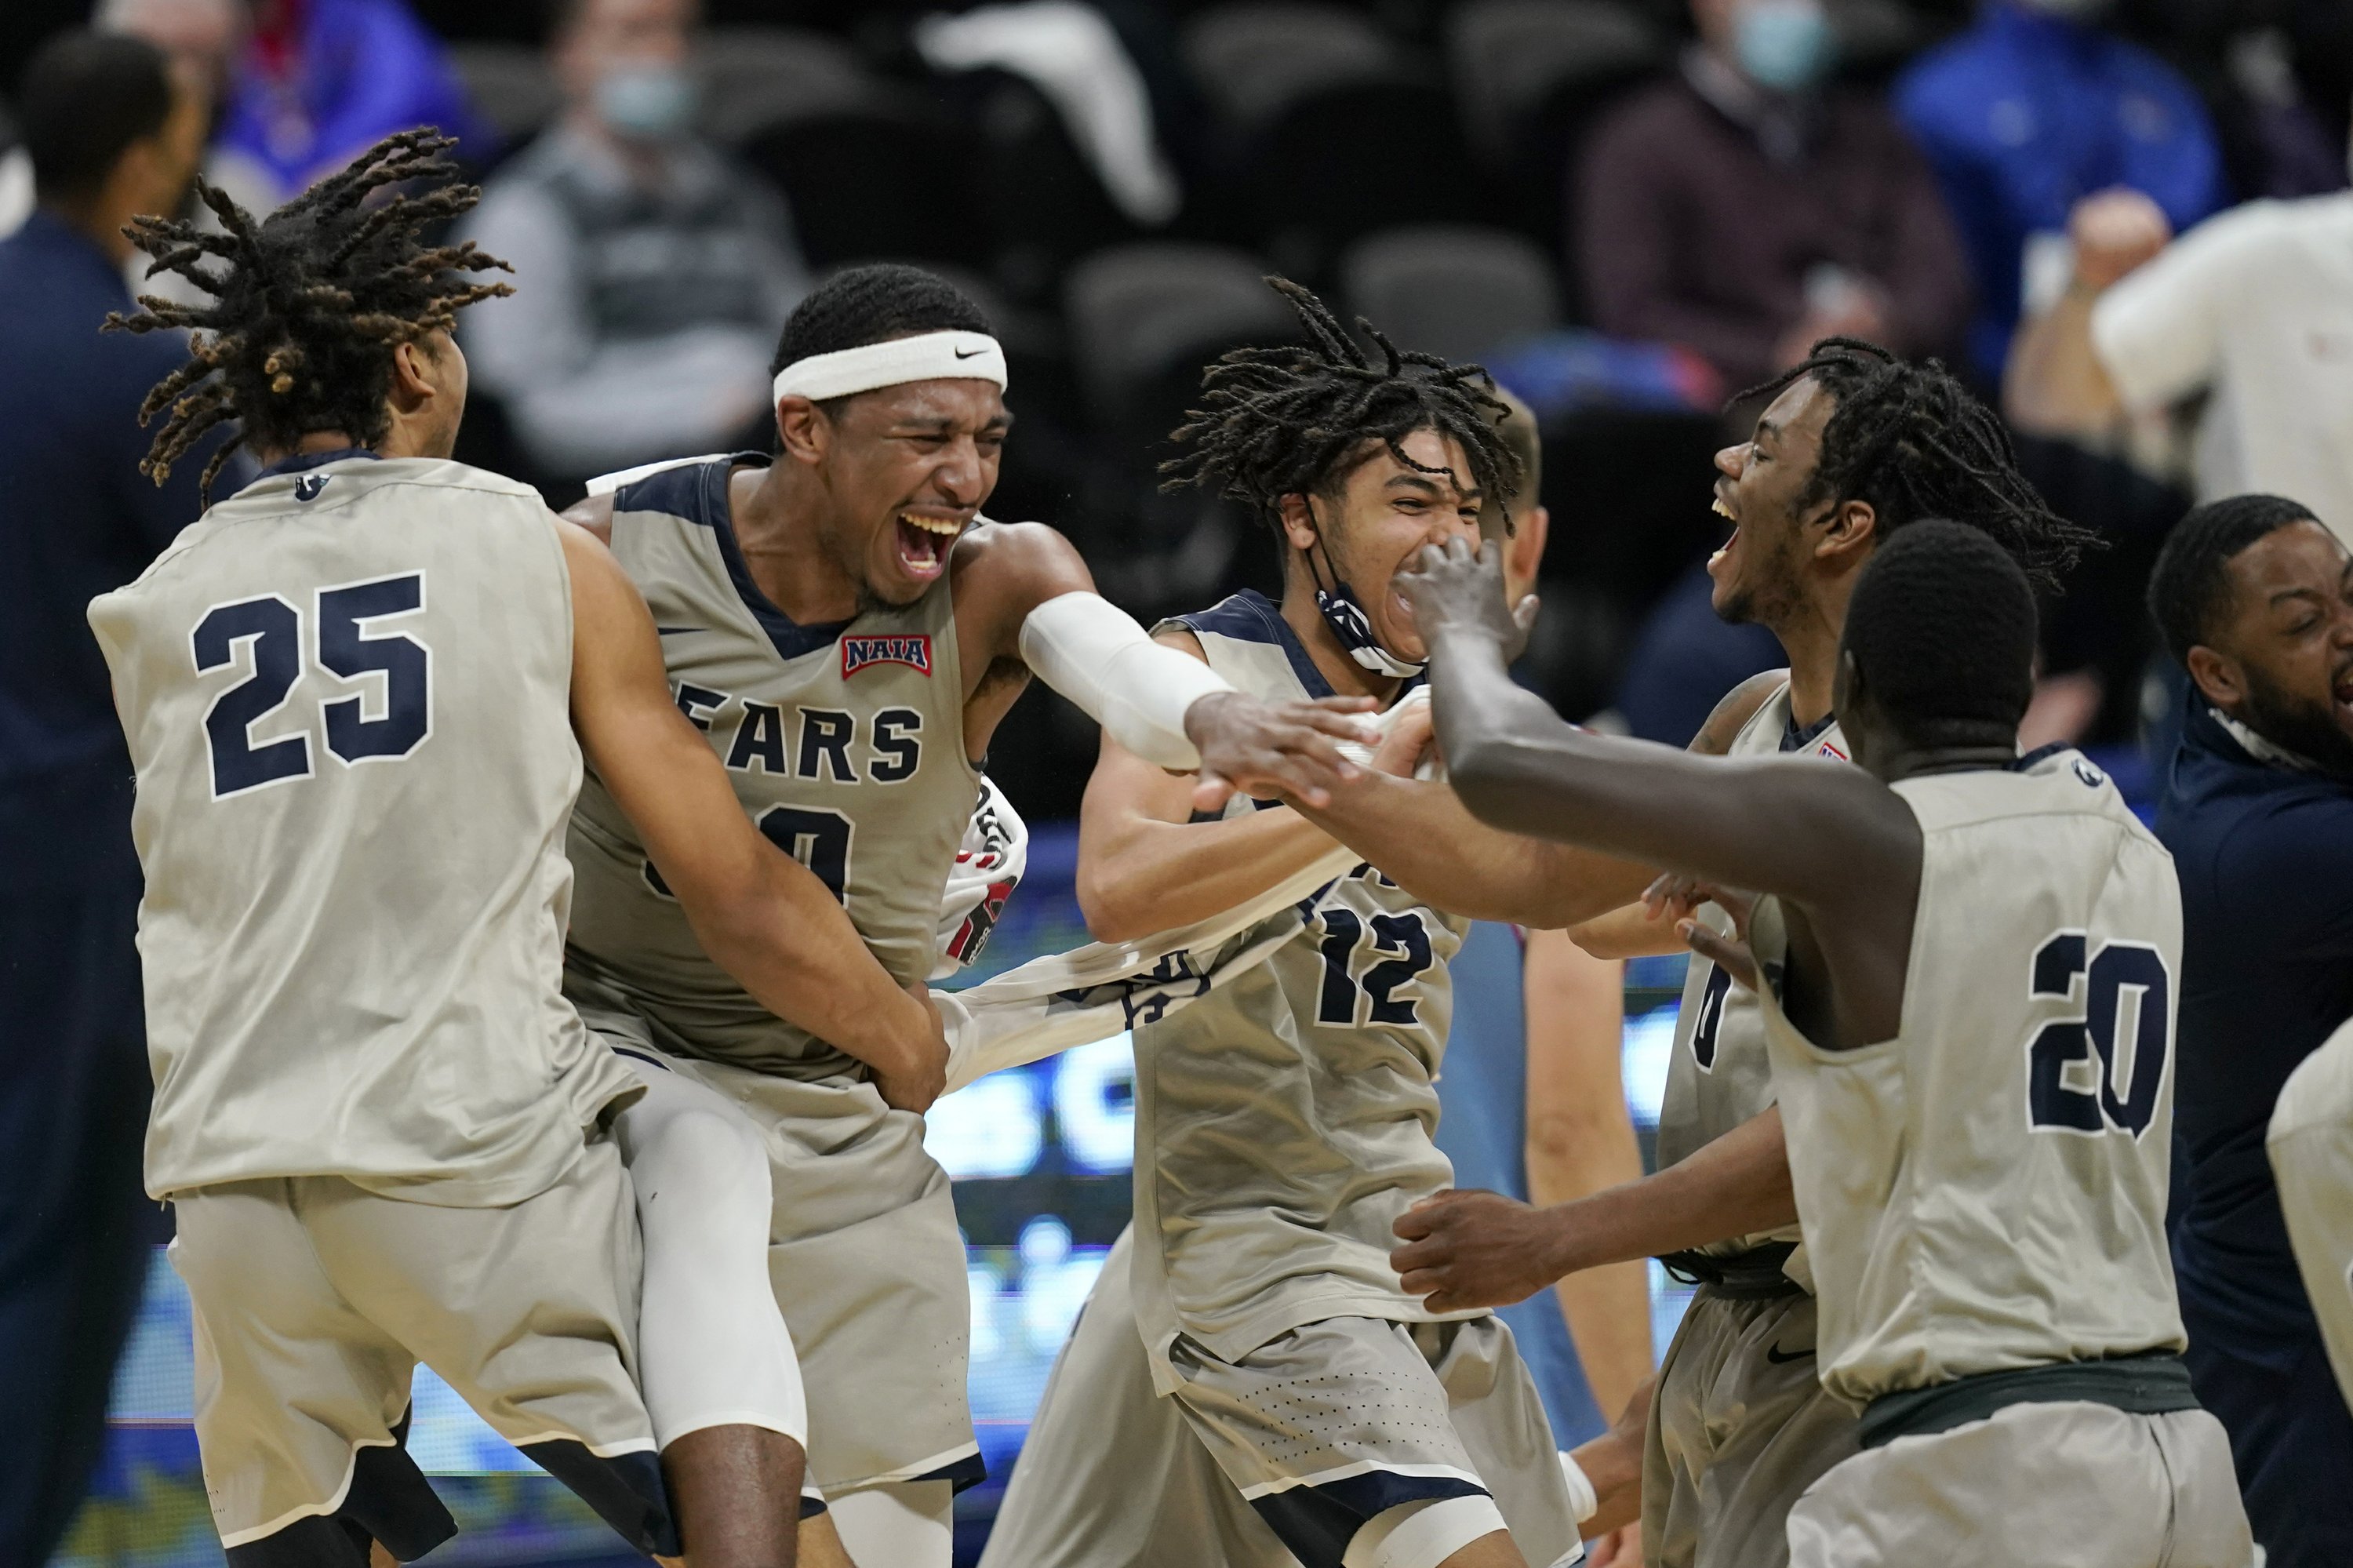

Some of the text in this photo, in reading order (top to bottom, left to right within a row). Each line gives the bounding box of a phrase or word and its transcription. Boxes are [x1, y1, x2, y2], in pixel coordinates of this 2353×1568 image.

[188, 569, 433, 802] 25
[846, 638, 928, 671] NAIA
[675, 679, 924, 785] EARS
[640, 802, 856, 910] 0
[1313, 902, 1435, 1030] 12
[2024, 927, 2172, 1146] 20
